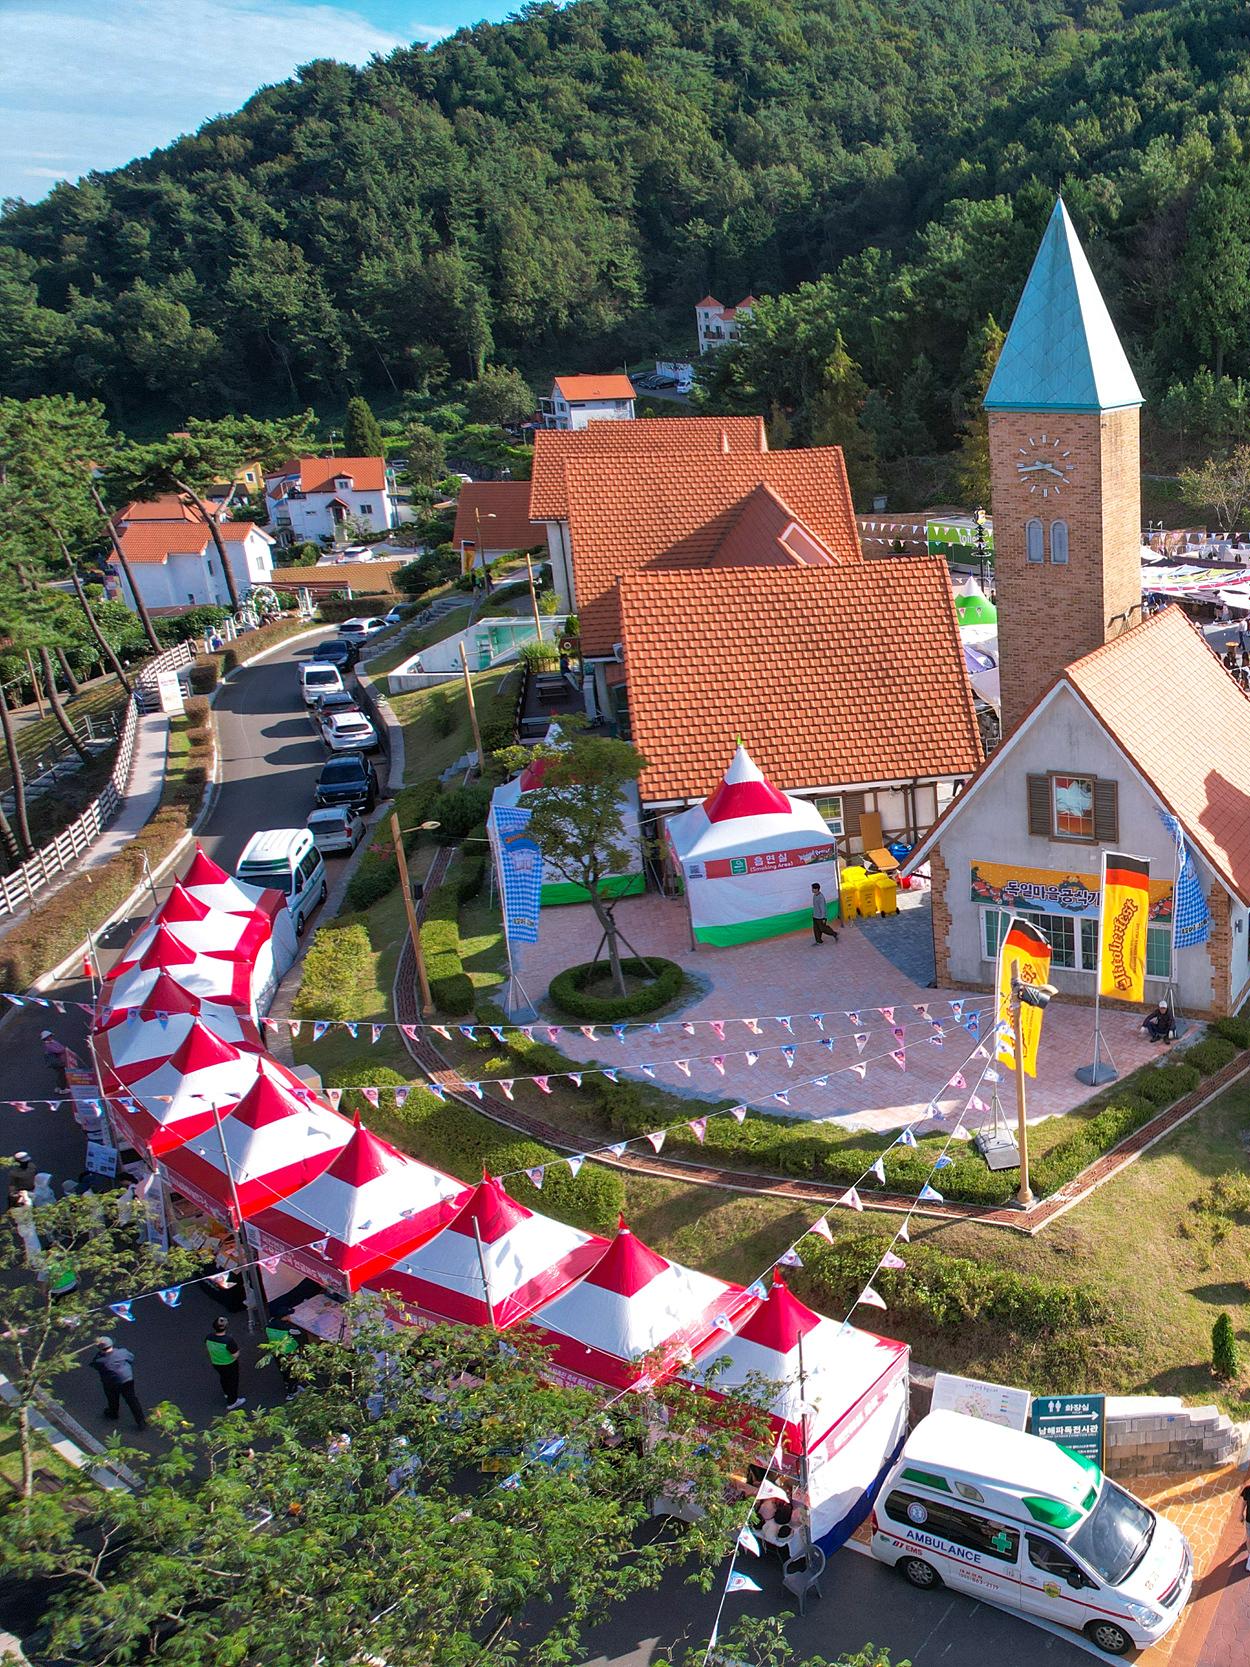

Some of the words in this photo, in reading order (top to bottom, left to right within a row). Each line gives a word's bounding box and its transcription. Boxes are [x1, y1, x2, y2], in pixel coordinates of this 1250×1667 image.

[1109, 898, 1139, 991] Oktoberfest
[1065, 1403, 1089, 1412] 화장실
[1038, 1424, 1099, 1436] 남해파독전시관
[905, 1545, 923, 1556] EMS
[906, 1529, 983, 1564] AMBULANCE
